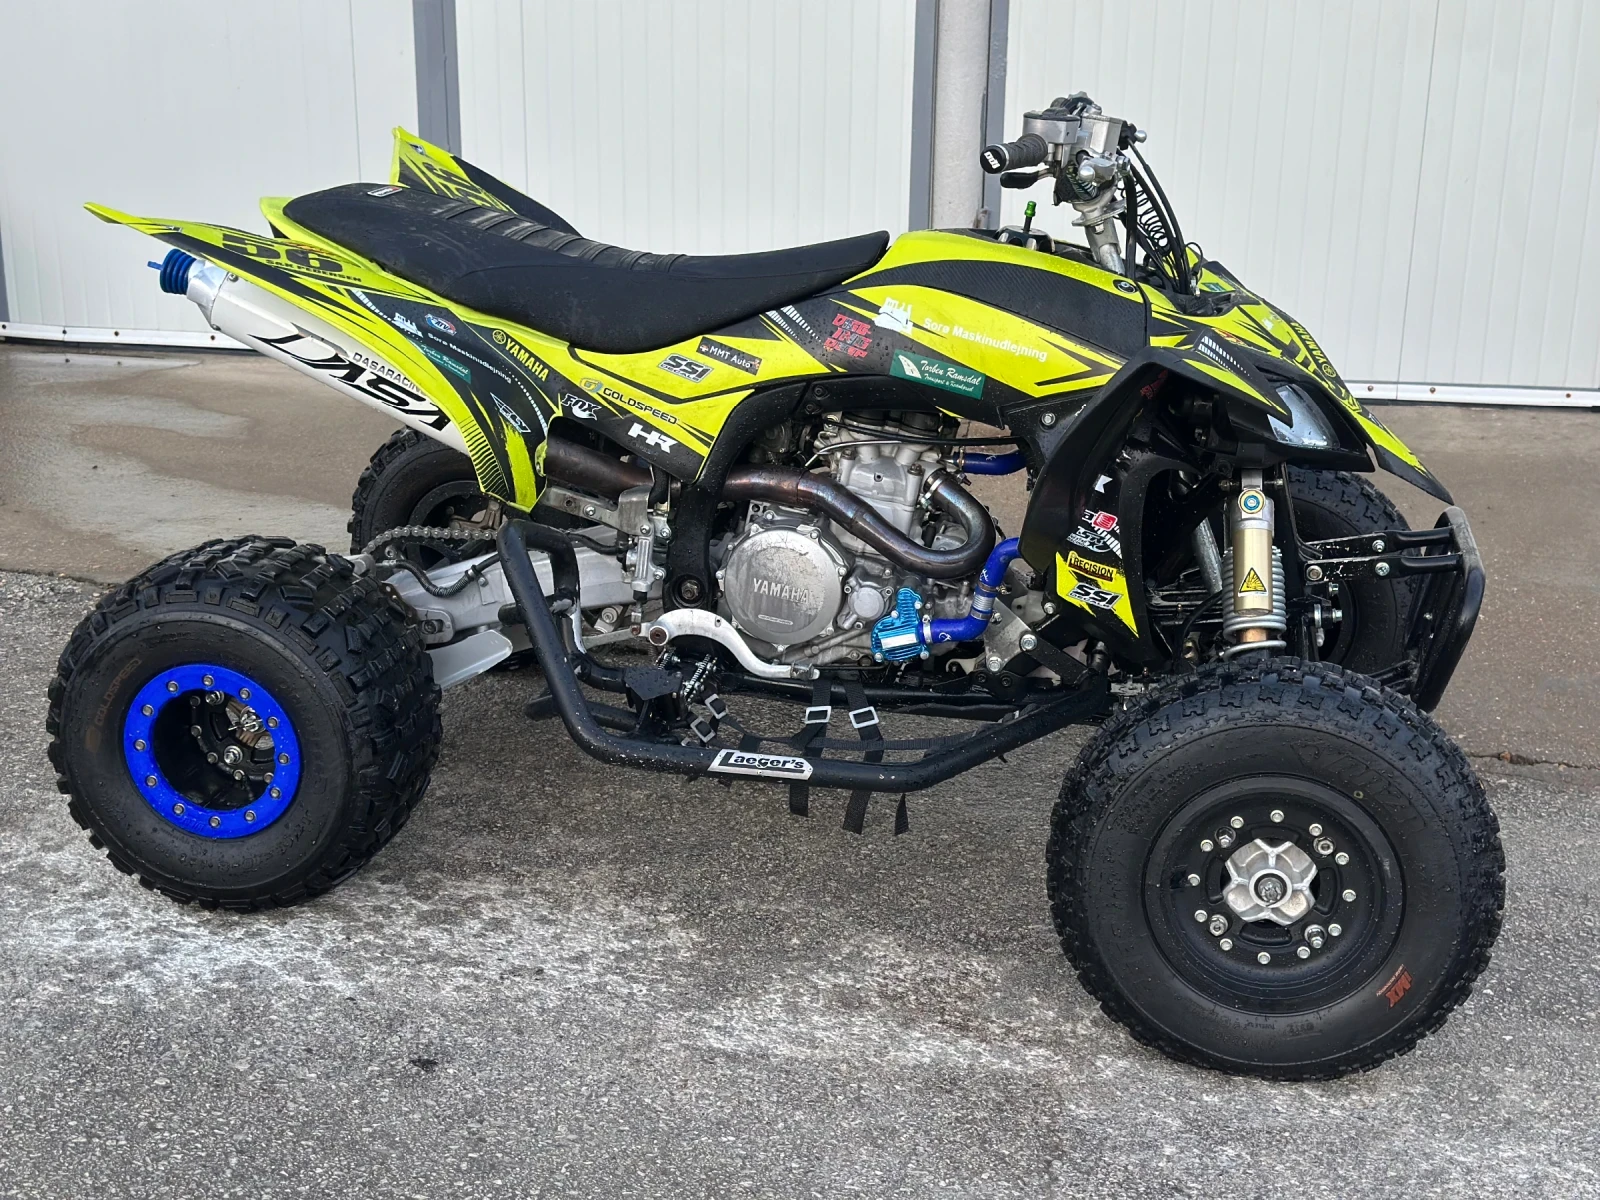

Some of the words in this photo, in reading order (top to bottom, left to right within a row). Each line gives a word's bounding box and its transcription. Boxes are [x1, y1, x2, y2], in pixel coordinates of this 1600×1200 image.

[709, 345, 731, 360] MMT
[730, 355, 751, 368] Auto
[952, 325, 1048, 363] Maskinudlejning
[504, 338, 550, 382] YAMAHA
[663, 355, 711, 379] SSI
[920, 360, 944, 375] Torben
[945, 367, 982, 386] Ramsdal
[602, 387, 677, 425] GOLDSPEED
[753, 577, 809, 604] YAMAHA
[1073, 583, 1122, 606] SSI
[718, 751, 806, 774] Laeger's
